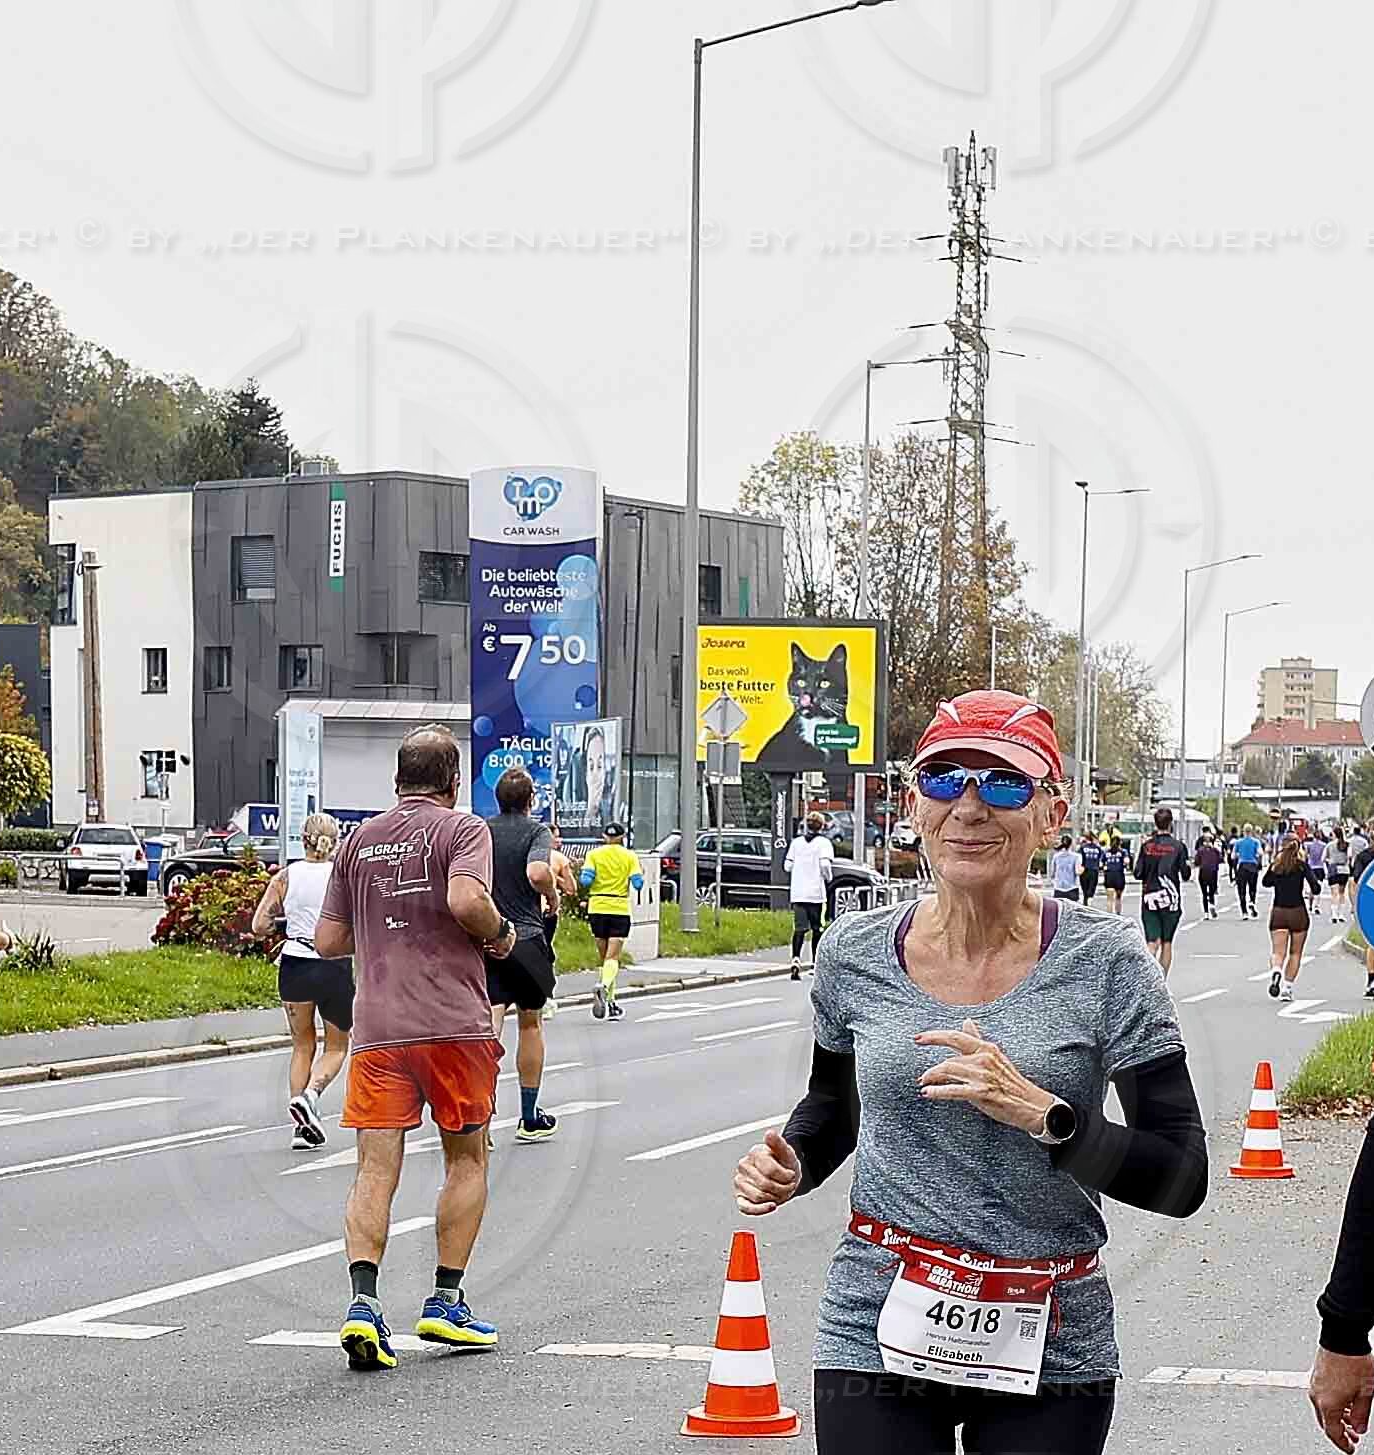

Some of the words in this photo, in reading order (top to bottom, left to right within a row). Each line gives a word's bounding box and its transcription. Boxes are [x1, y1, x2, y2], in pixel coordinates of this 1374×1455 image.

[333, 503, 342, 574] FUCHS
[503, 527, 526, 536] CAR
[527, 527, 560, 536] WASH
[482, 569, 505, 582] Die
[507, 568, 587, 582] beliebteste
[489, 584, 579, 598] Autowäsche
[503, 600, 528, 613] der
[530, 600, 564, 613] Welt
[483, 623, 496, 632] Ab
[701, 637, 747, 649] Josera
[707, 667, 724, 676] Das
[726, 666, 749, 676] wohl
[700, 680, 734, 691] beste
[737, 680, 776, 691] Futter
[500, 735, 554, 751] TÄGLIC
[488, 754, 524, 768] 8:00
[374, 842, 407, 855] GRAZ
[930, 1265, 956, 1280] GRAZ
[926, 1272, 980, 1296] MARATHON
[926, 1299, 1001, 1334] 4618
[926, 1345, 983, 1362] Elisabeth
